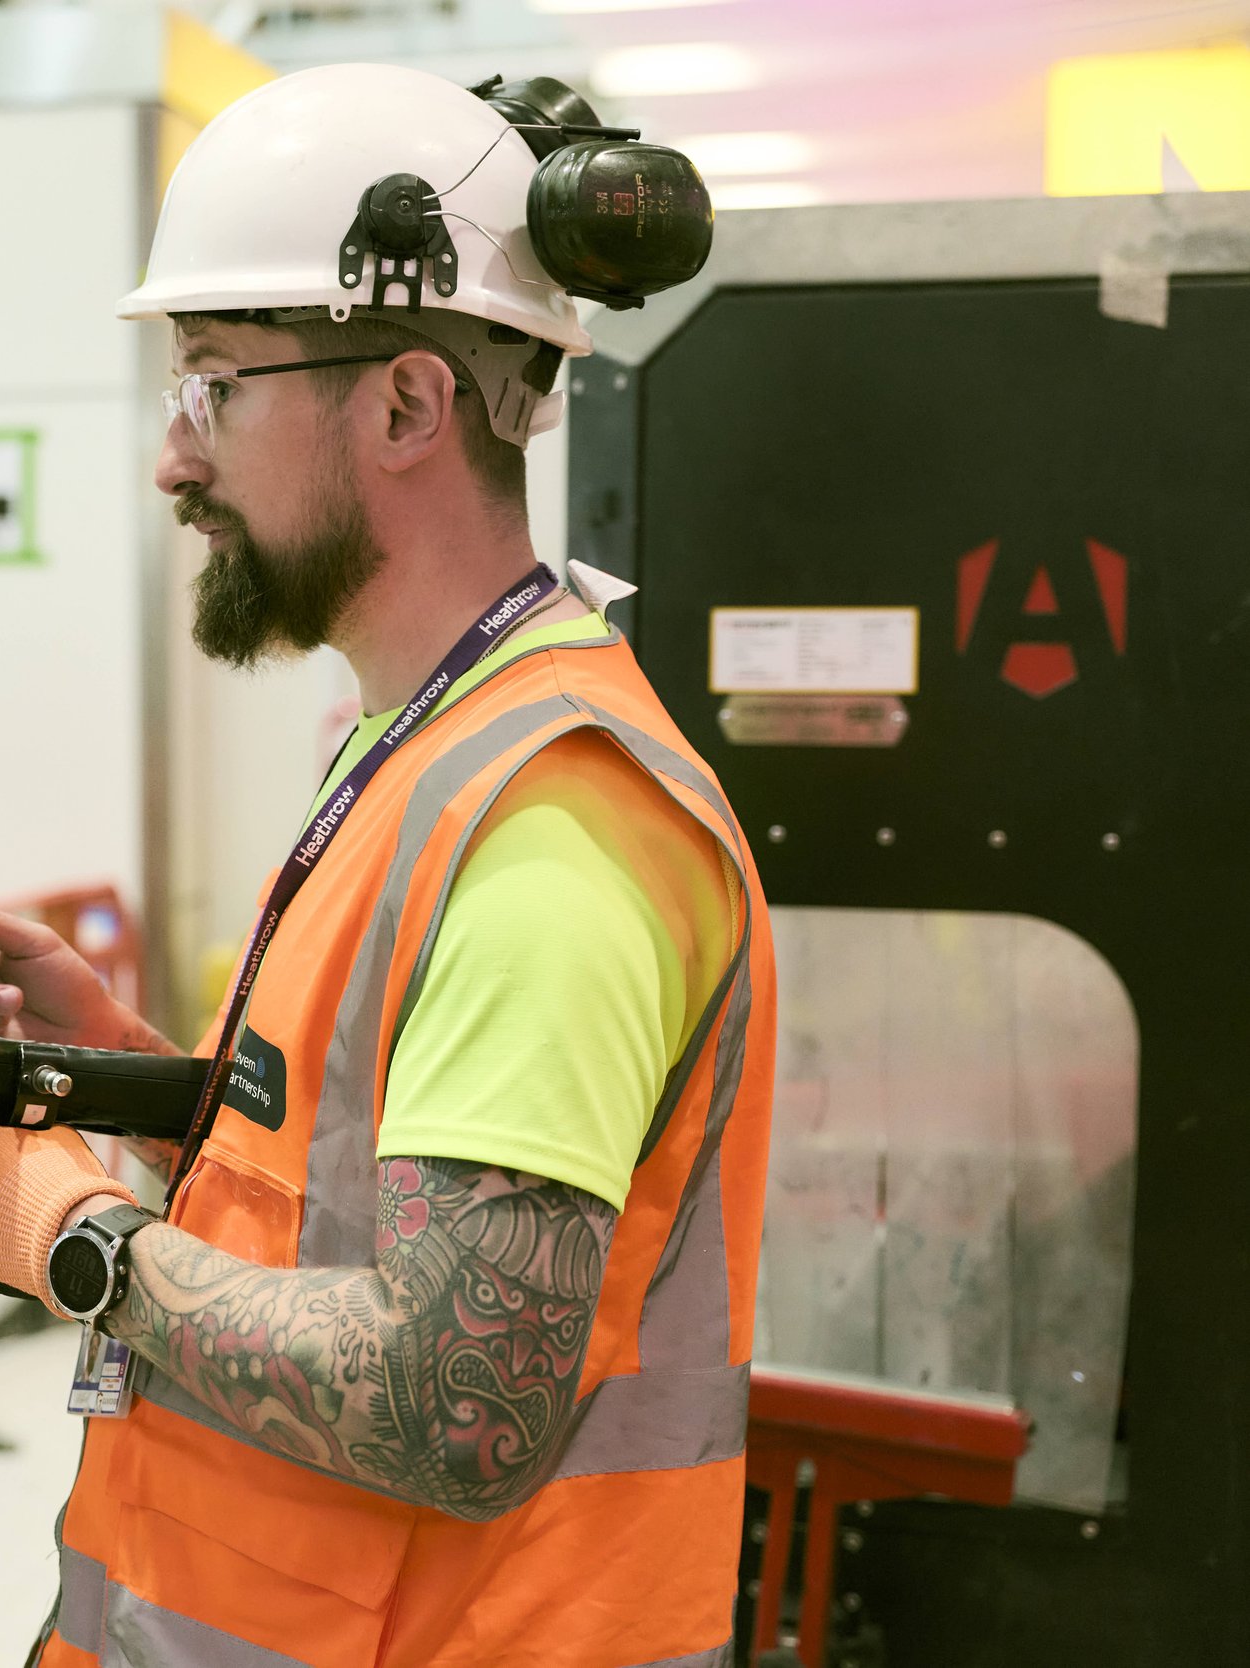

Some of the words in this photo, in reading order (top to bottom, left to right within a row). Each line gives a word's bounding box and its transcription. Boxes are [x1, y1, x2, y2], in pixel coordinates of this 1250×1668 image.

[635, 173, 645, 238] PELTOR
[479, 582, 541, 636] Heathrow
[383, 671, 450, 745] Heathrow
[295, 785, 355, 867] Heathrow
[239, 910, 279, 996] Heathrow
[193, 1048, 227, 1132] Heathrow
[229, 1072, 271, 1108] artnership
[236, 1051, 256, 1073] evern
